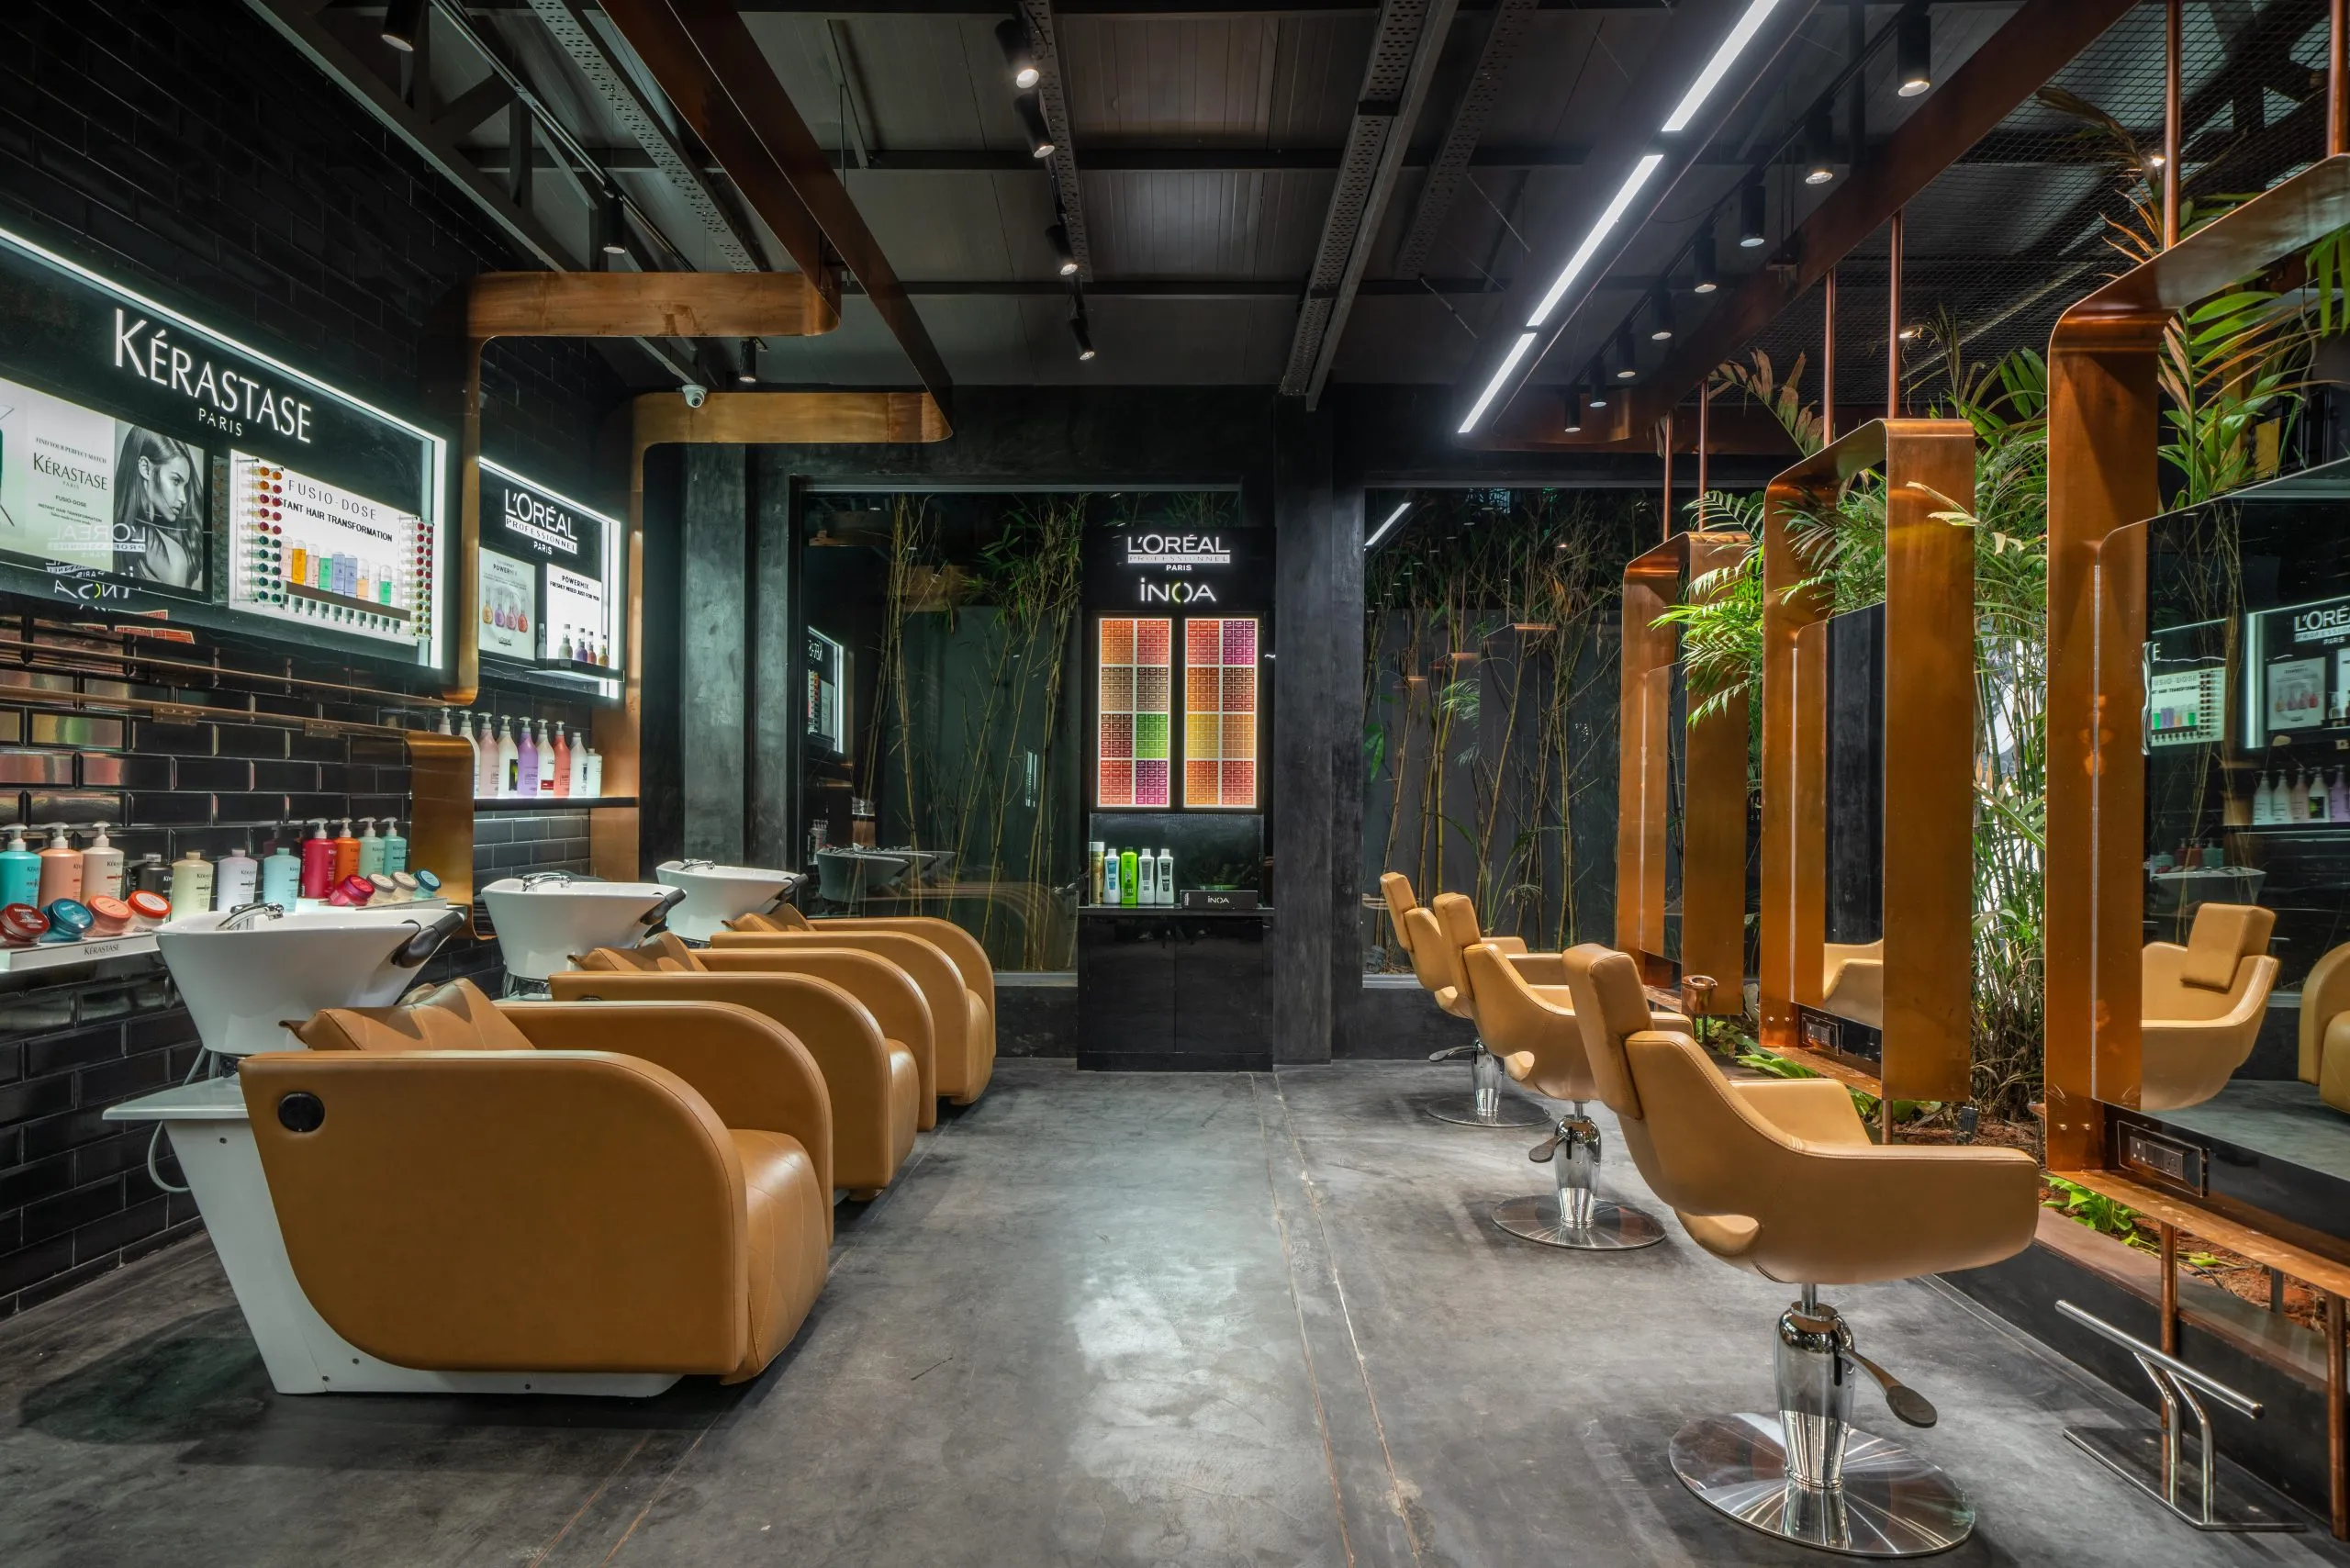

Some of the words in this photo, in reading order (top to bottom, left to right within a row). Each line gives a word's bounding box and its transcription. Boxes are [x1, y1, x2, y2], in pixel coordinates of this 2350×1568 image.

[115, 308, 311, 443] KÉRASTASE
[198, 408, 243, 437] PARIS
[33, 452, 107, 491] KÉRASTASE
[55, 495, 87, 508] FUSIO-DOSE
[288, 479, 377, 521] FUSIO-DOSE
[505, 488, 577, 541] L'ORÉAL
[306, 507, 325, 521] HAIR
[327, 514, 393, 543] TRANSFORMATION
[506, 517, 576, 552] PROFESSIONNEL
[533, 541, 553, 555] PARIS
[1127, 533, 1231, 554] L'ORÉAL
[1129, 554, 1229, 563] PROFESSIONNEL
[562, 575, 589, 589] POWERMIX
